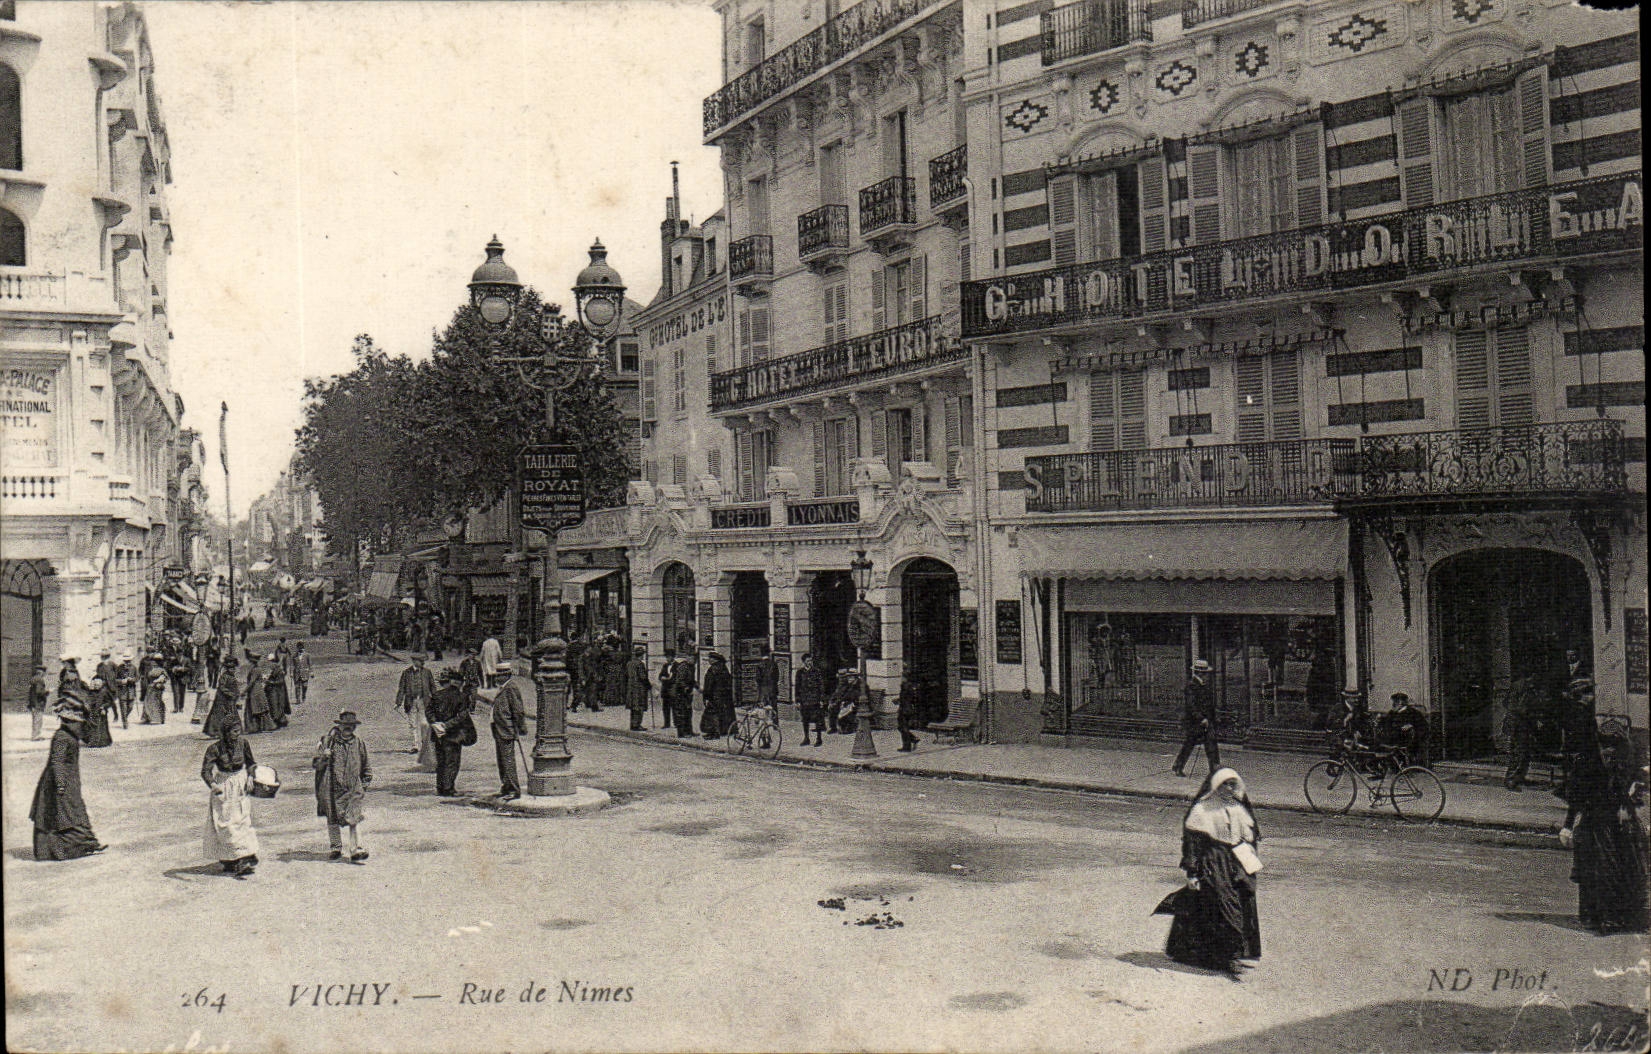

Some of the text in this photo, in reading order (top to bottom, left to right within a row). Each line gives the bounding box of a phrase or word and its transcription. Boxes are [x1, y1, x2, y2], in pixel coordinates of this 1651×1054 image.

[1043, 249, 1246, 313] HOTEL
[658, 313, 689, 346] HOTEL
[691, 307, 705, 333] DE
[747, 361, 799, 399] HOTEL
[524, 454, 577, 469] TAILLERIE
[523, 479, 580, 492] ROYAT
[541, 470, 561, 478] DE
[1024, 449, 1332, 499] SPLENDID
[538, 518, 568, 528] VICHY
[791, 501, 860, 525] LYONNAIS
